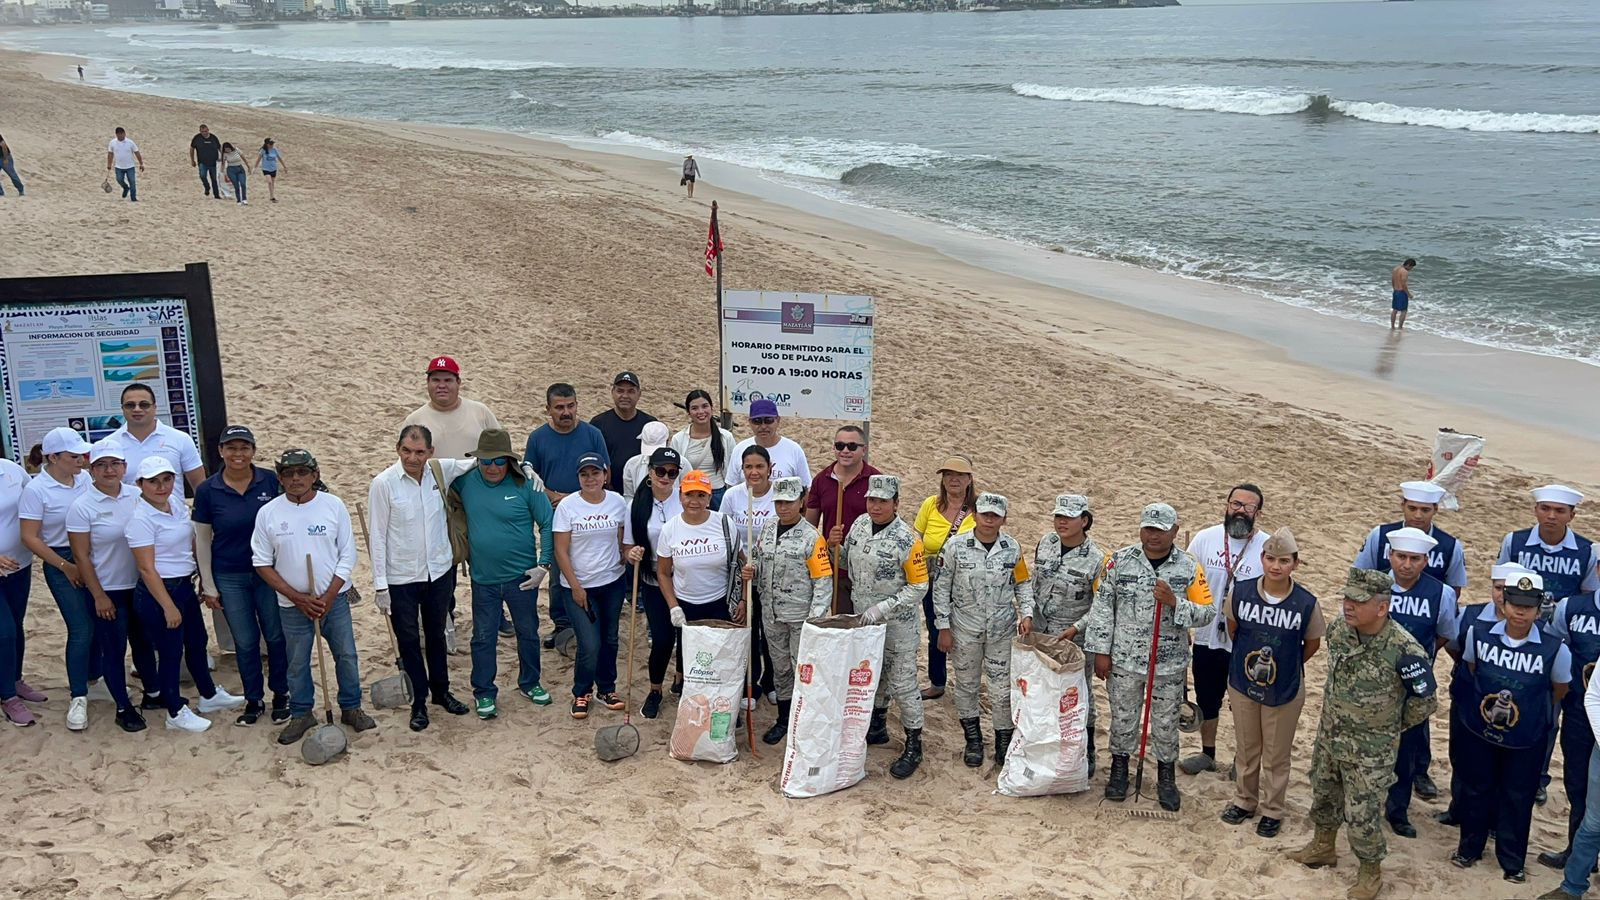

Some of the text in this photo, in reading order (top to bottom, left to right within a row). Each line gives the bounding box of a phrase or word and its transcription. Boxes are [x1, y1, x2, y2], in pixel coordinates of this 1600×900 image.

[28, 332, 83, 341] INFORMACION
[96, 328, 140, 337] SEGURIDAD
[731, 341, 864, 355] HORARIO PERMITIDO PARA EL
[761, 352, 833, 363] USO DE PLAYAS:
[732, 365, 863, 380] DE 7:00 A 19:00 HORAS
[664, 449, 676, 458] alo
[672, 544, 720, 556] IMMUJER
[1518, 551, 1581, 576] MARINA
[1389, 595, 1431, 619] RINA
[1238, 600, 1302, 630] MARINA
[1476, 640, 1544, 674] MARINA
[1400, 667, 1426, 680] MARINA
[1401, 662, 1420, 673] PLAN
[781, 759, 793, 788] PROTEINA
